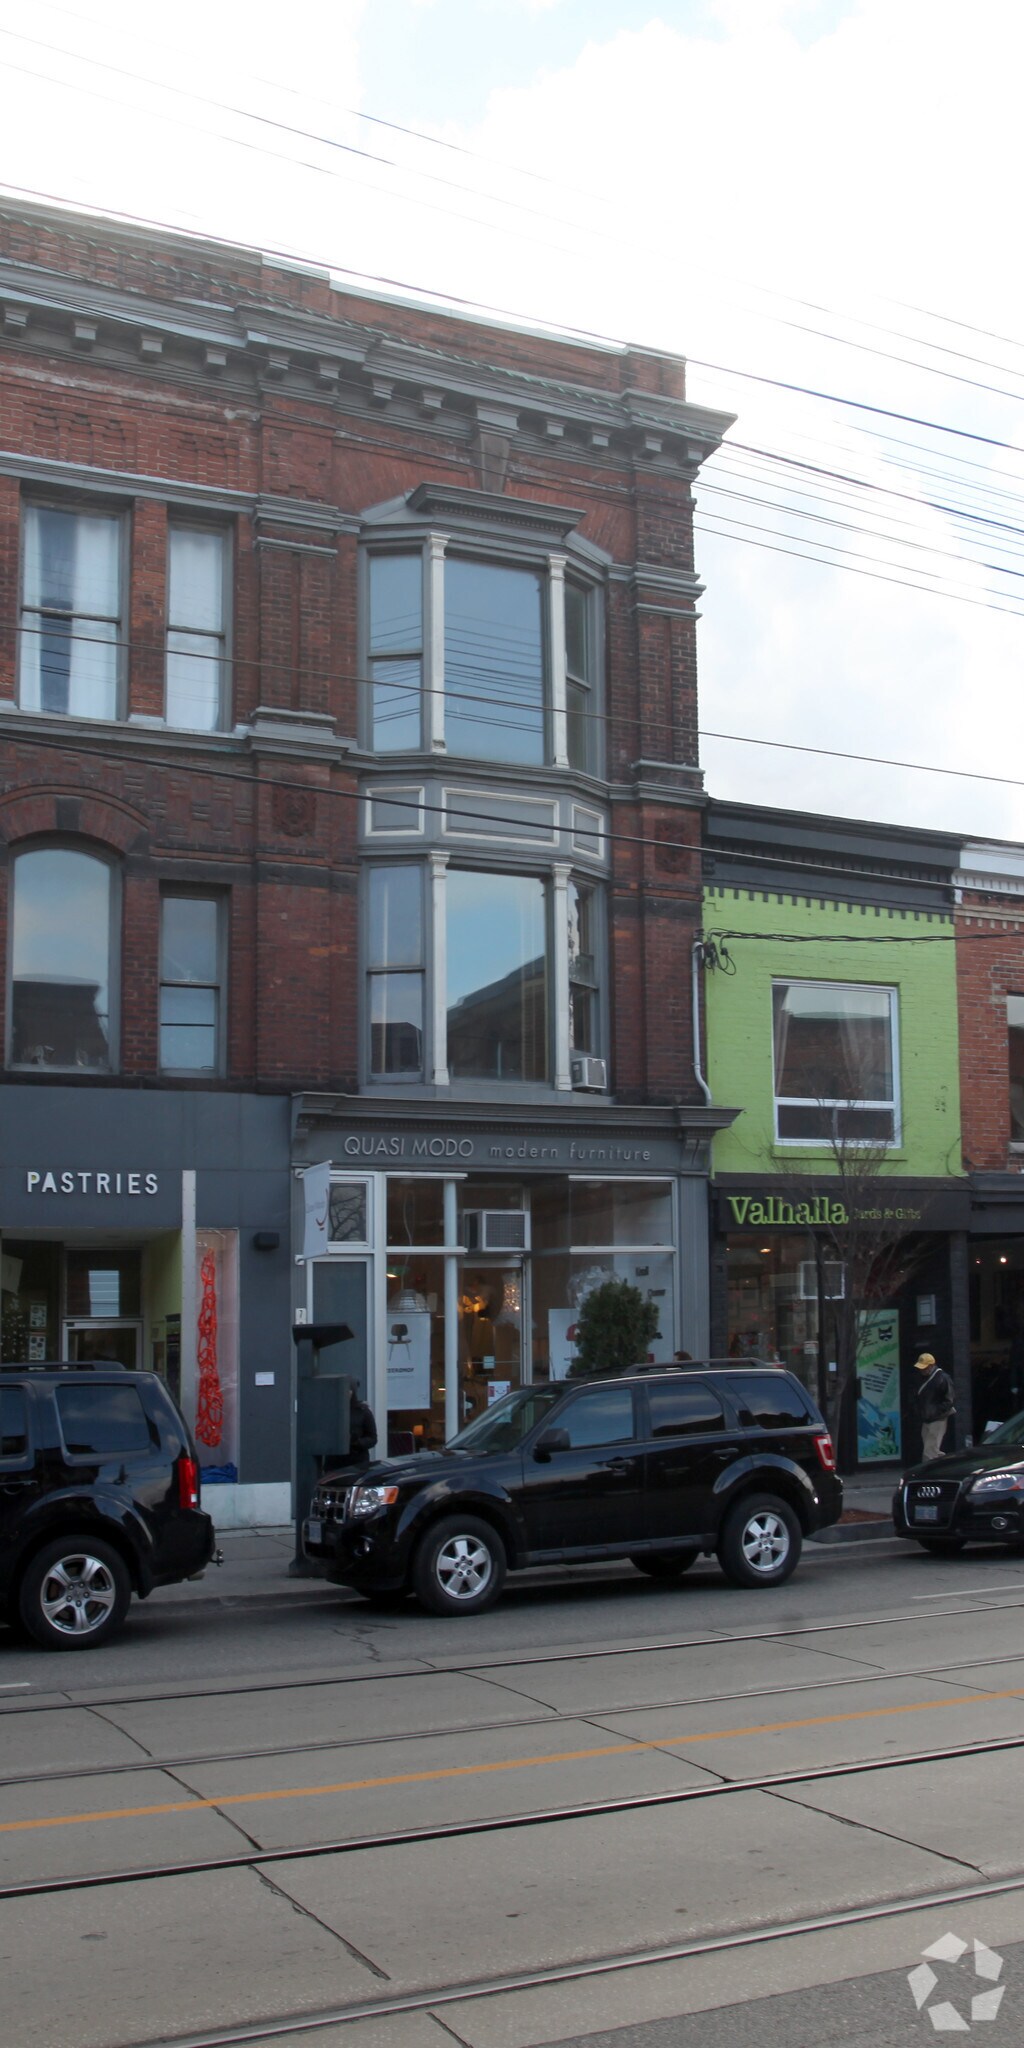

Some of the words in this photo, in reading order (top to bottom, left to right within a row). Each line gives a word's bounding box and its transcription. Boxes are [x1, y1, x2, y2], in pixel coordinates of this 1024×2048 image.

[344, 1136, 404, 1155] QUASI
[412, 1138, 474, 1157] MODO
[489, 1140, 558, 1158] modern
[569, 1142, 651, 1160] furniture
[27, 1171, 158, 1195] PASTRIES
[727, 1196, 849, 1225] Valhalla
